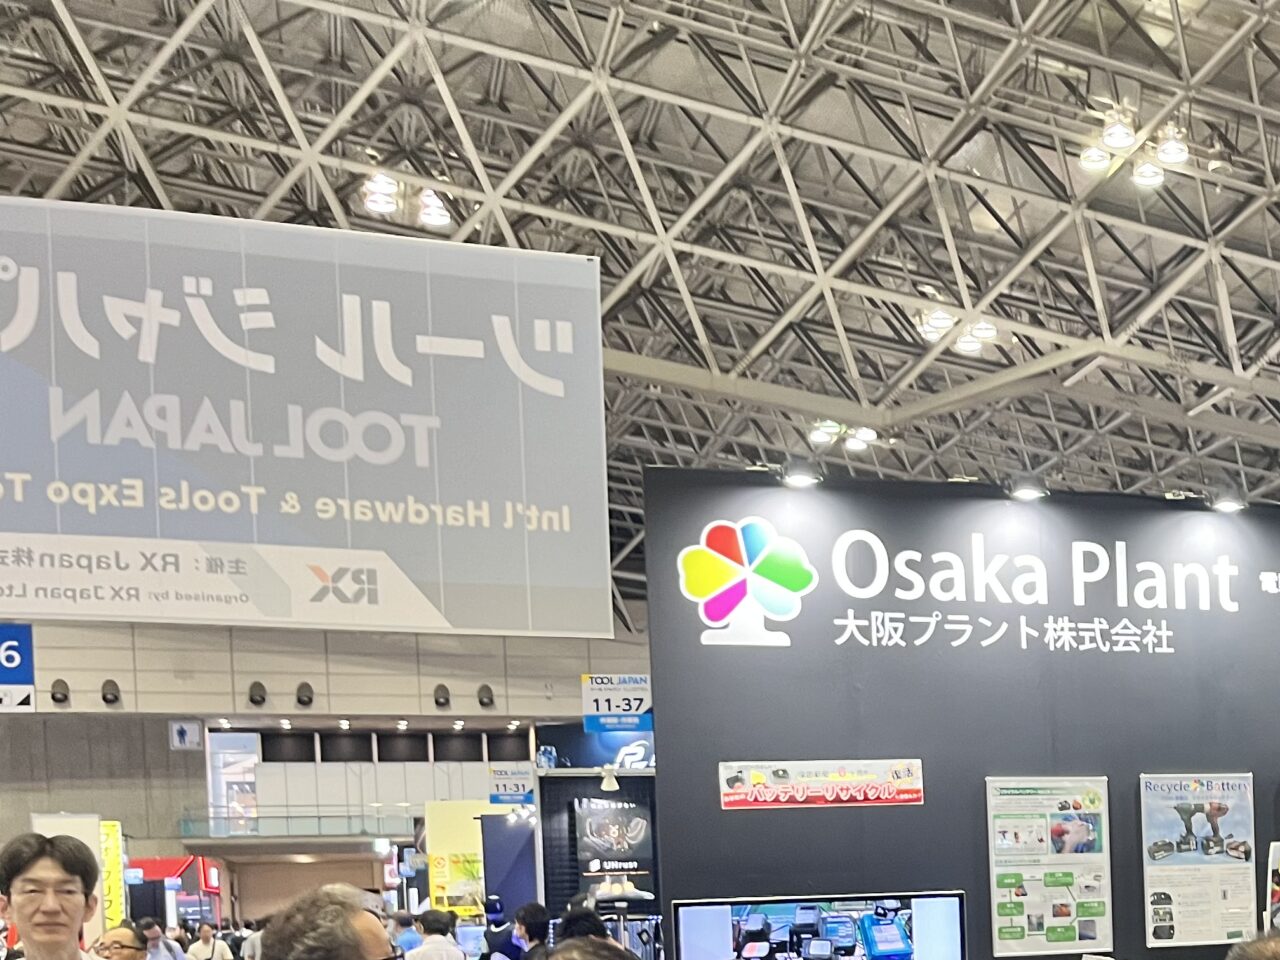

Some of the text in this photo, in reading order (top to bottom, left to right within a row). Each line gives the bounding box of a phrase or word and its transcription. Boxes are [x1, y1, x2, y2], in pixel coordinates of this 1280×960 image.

[832, 528, 1240, 613] Osaka Plant
[833, 609, 1175, 655] 大阪プラント株式会社
[592, 697, 644, 712] 11-37
[495, 783, 526, 793] 11-31
[746, 782, 897, 803] バッテリーリサイクル
[1145, 780, 1250, 793] Recycle Battery
